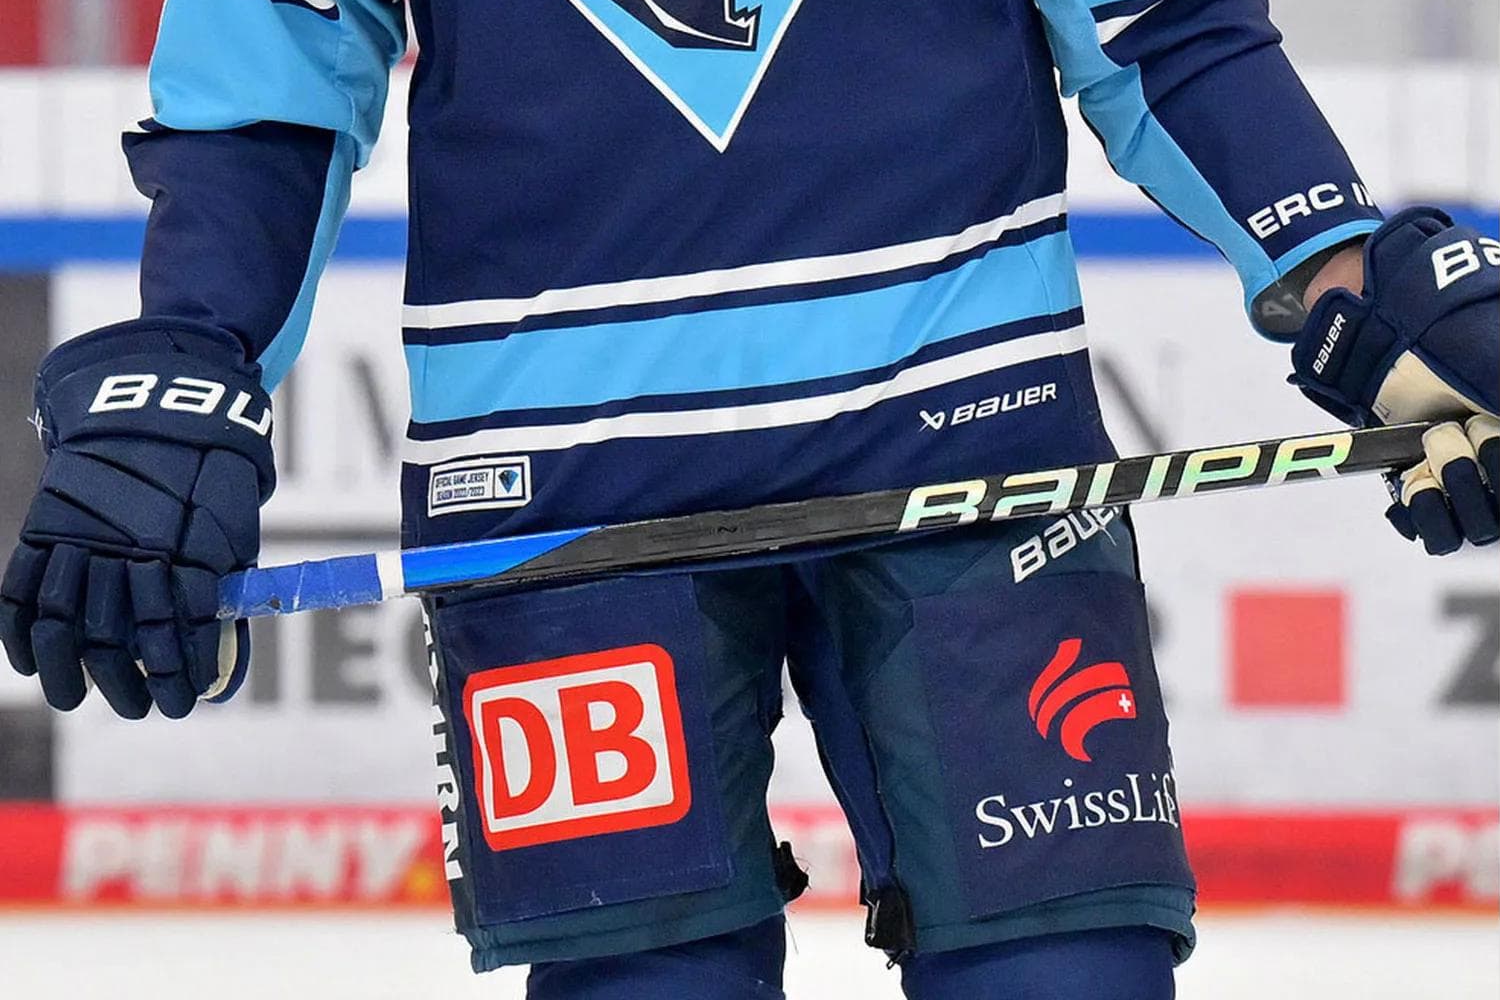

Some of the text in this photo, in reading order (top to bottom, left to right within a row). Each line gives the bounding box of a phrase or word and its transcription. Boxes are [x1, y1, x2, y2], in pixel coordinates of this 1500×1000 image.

[1247, 182, 1345, 240] ERC
[950, 382, 1058, 427] BAUER
[1009, 504, 1120, 584] BAUE
[480, 680, 658, 820] DB
